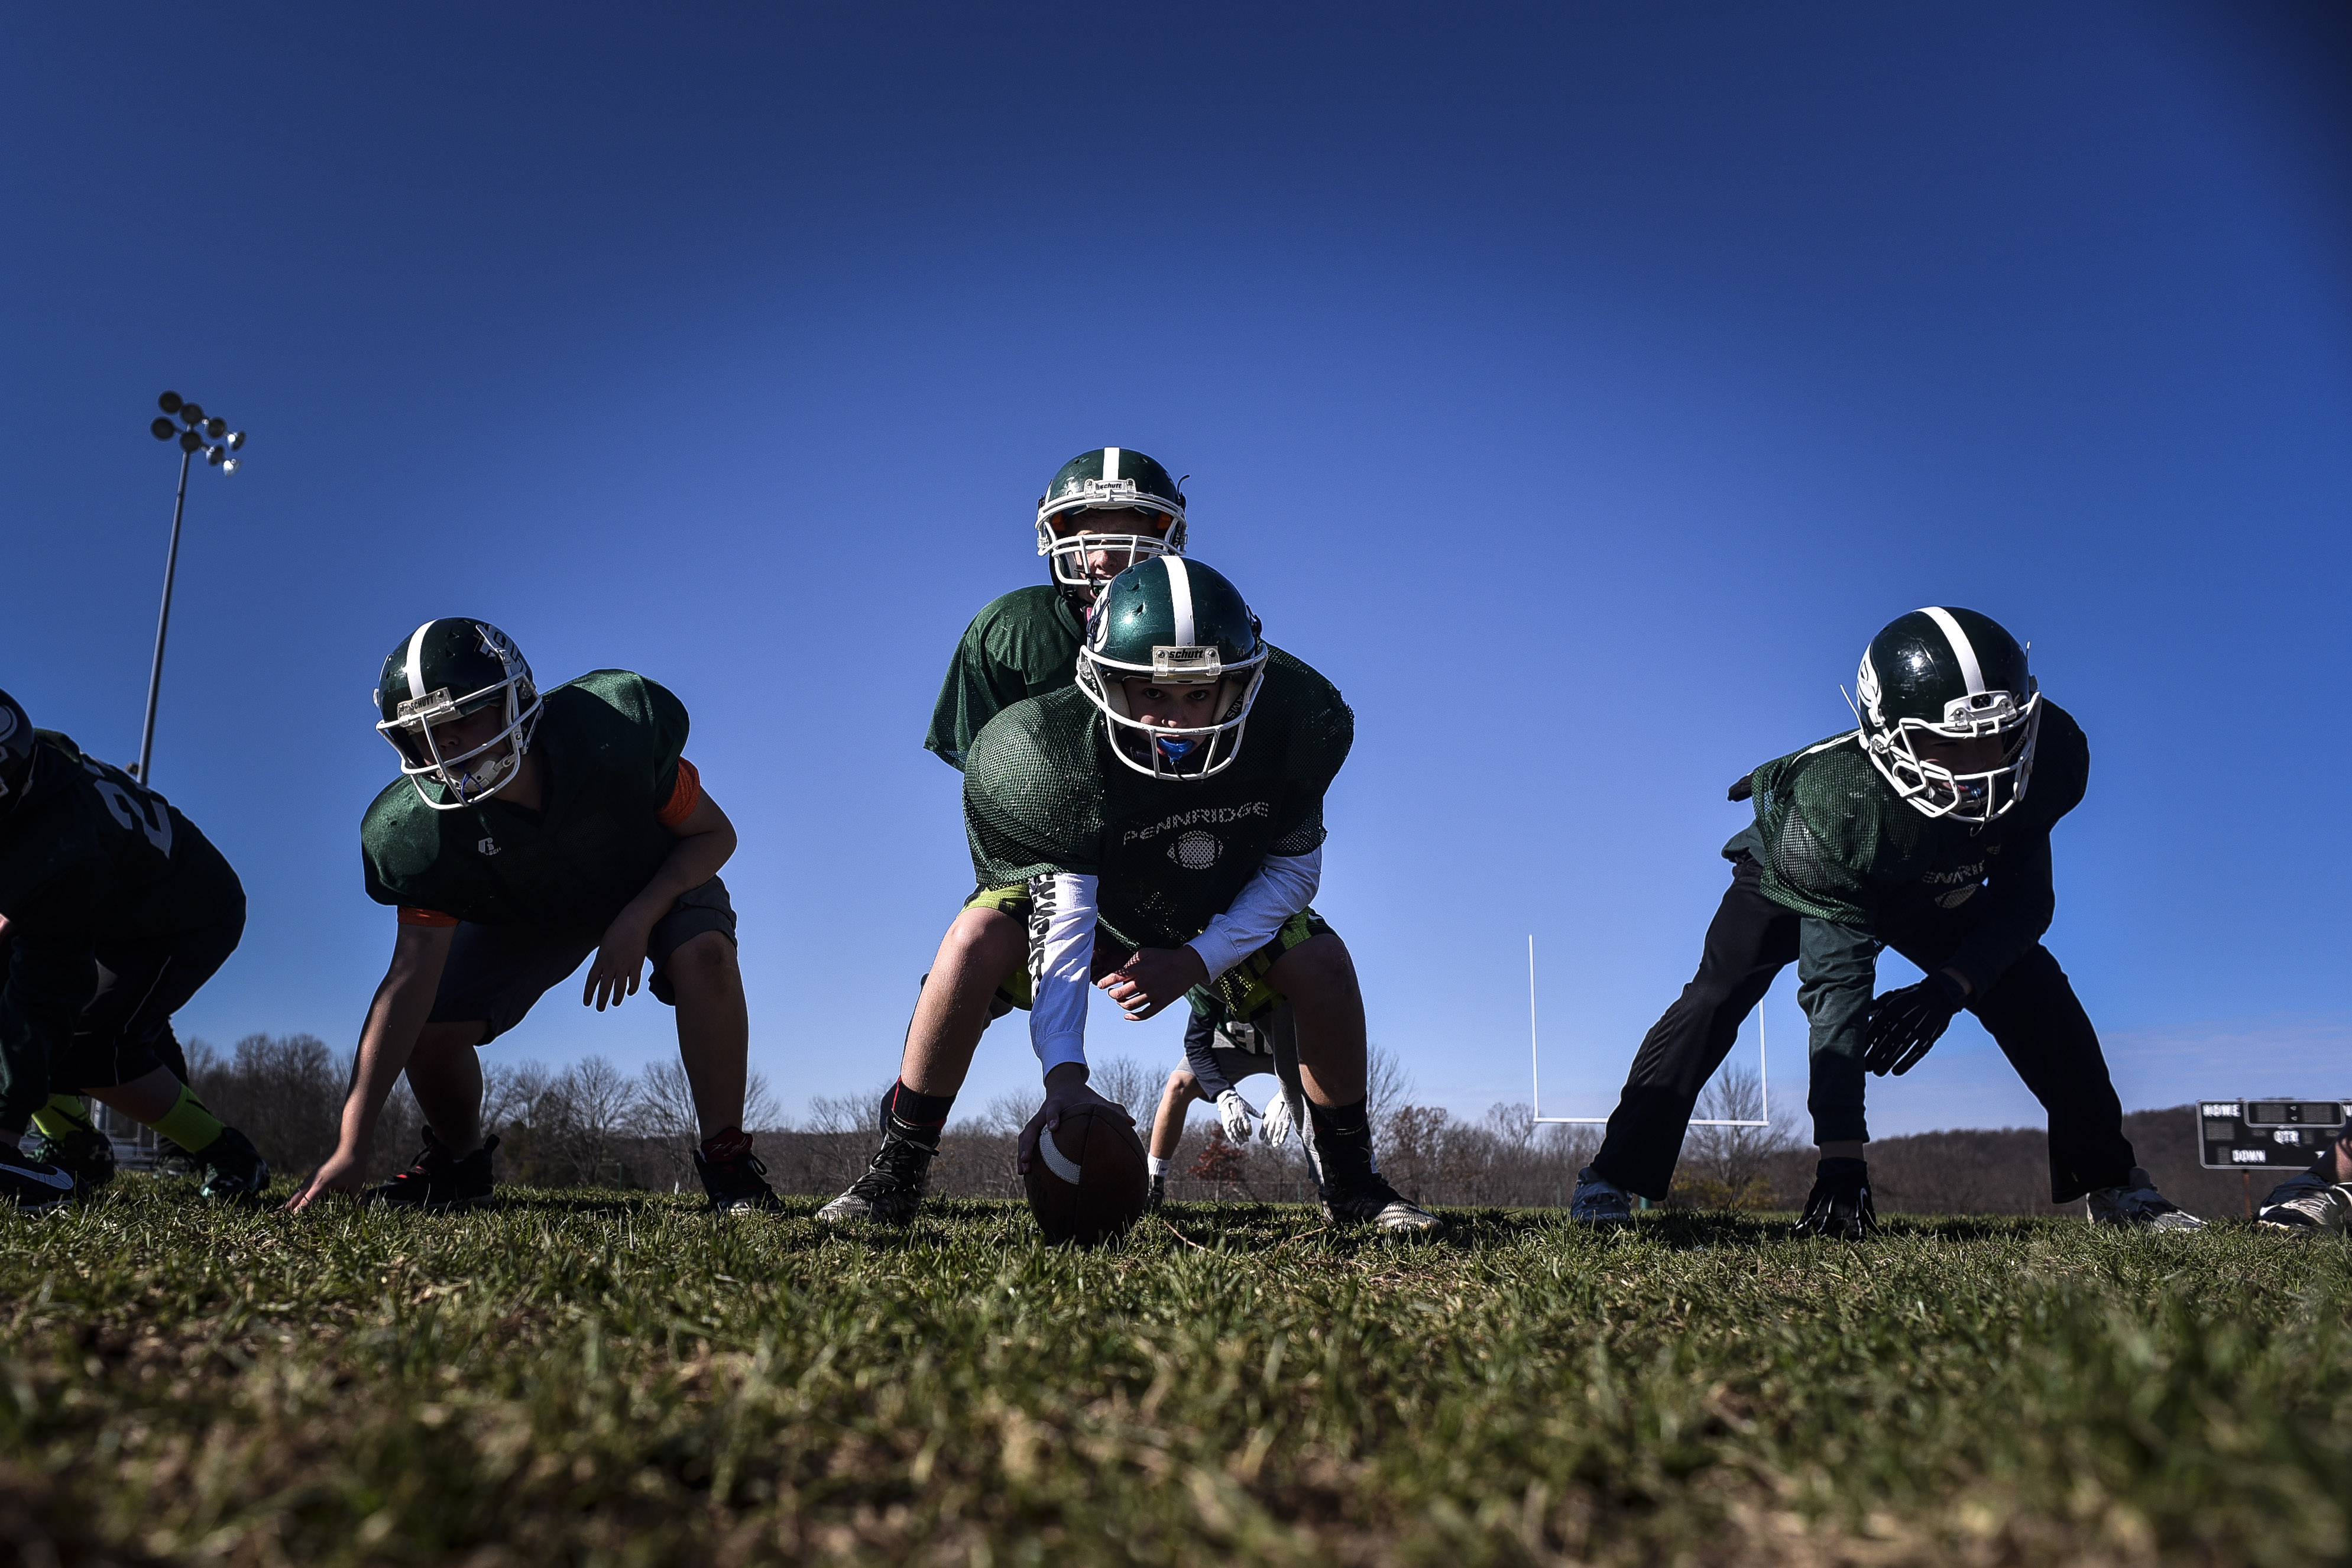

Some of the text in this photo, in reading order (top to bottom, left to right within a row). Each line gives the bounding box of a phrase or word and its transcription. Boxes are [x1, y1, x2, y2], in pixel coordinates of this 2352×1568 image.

[1168, 649, 1204, 659] schutt
[410, 695, 434, 710] SCHUTT
[1227, 691, 1245, 718] AMS
[94, 762, 171, 859] 2
[1123, 801, 1269, 845] PENNRIDGE
[2202, 1104, 2241, 1117] HOME
[2273, 1130, 2299, 1145] QTR
[2232, 1150, 2266, 1162] DOWN
